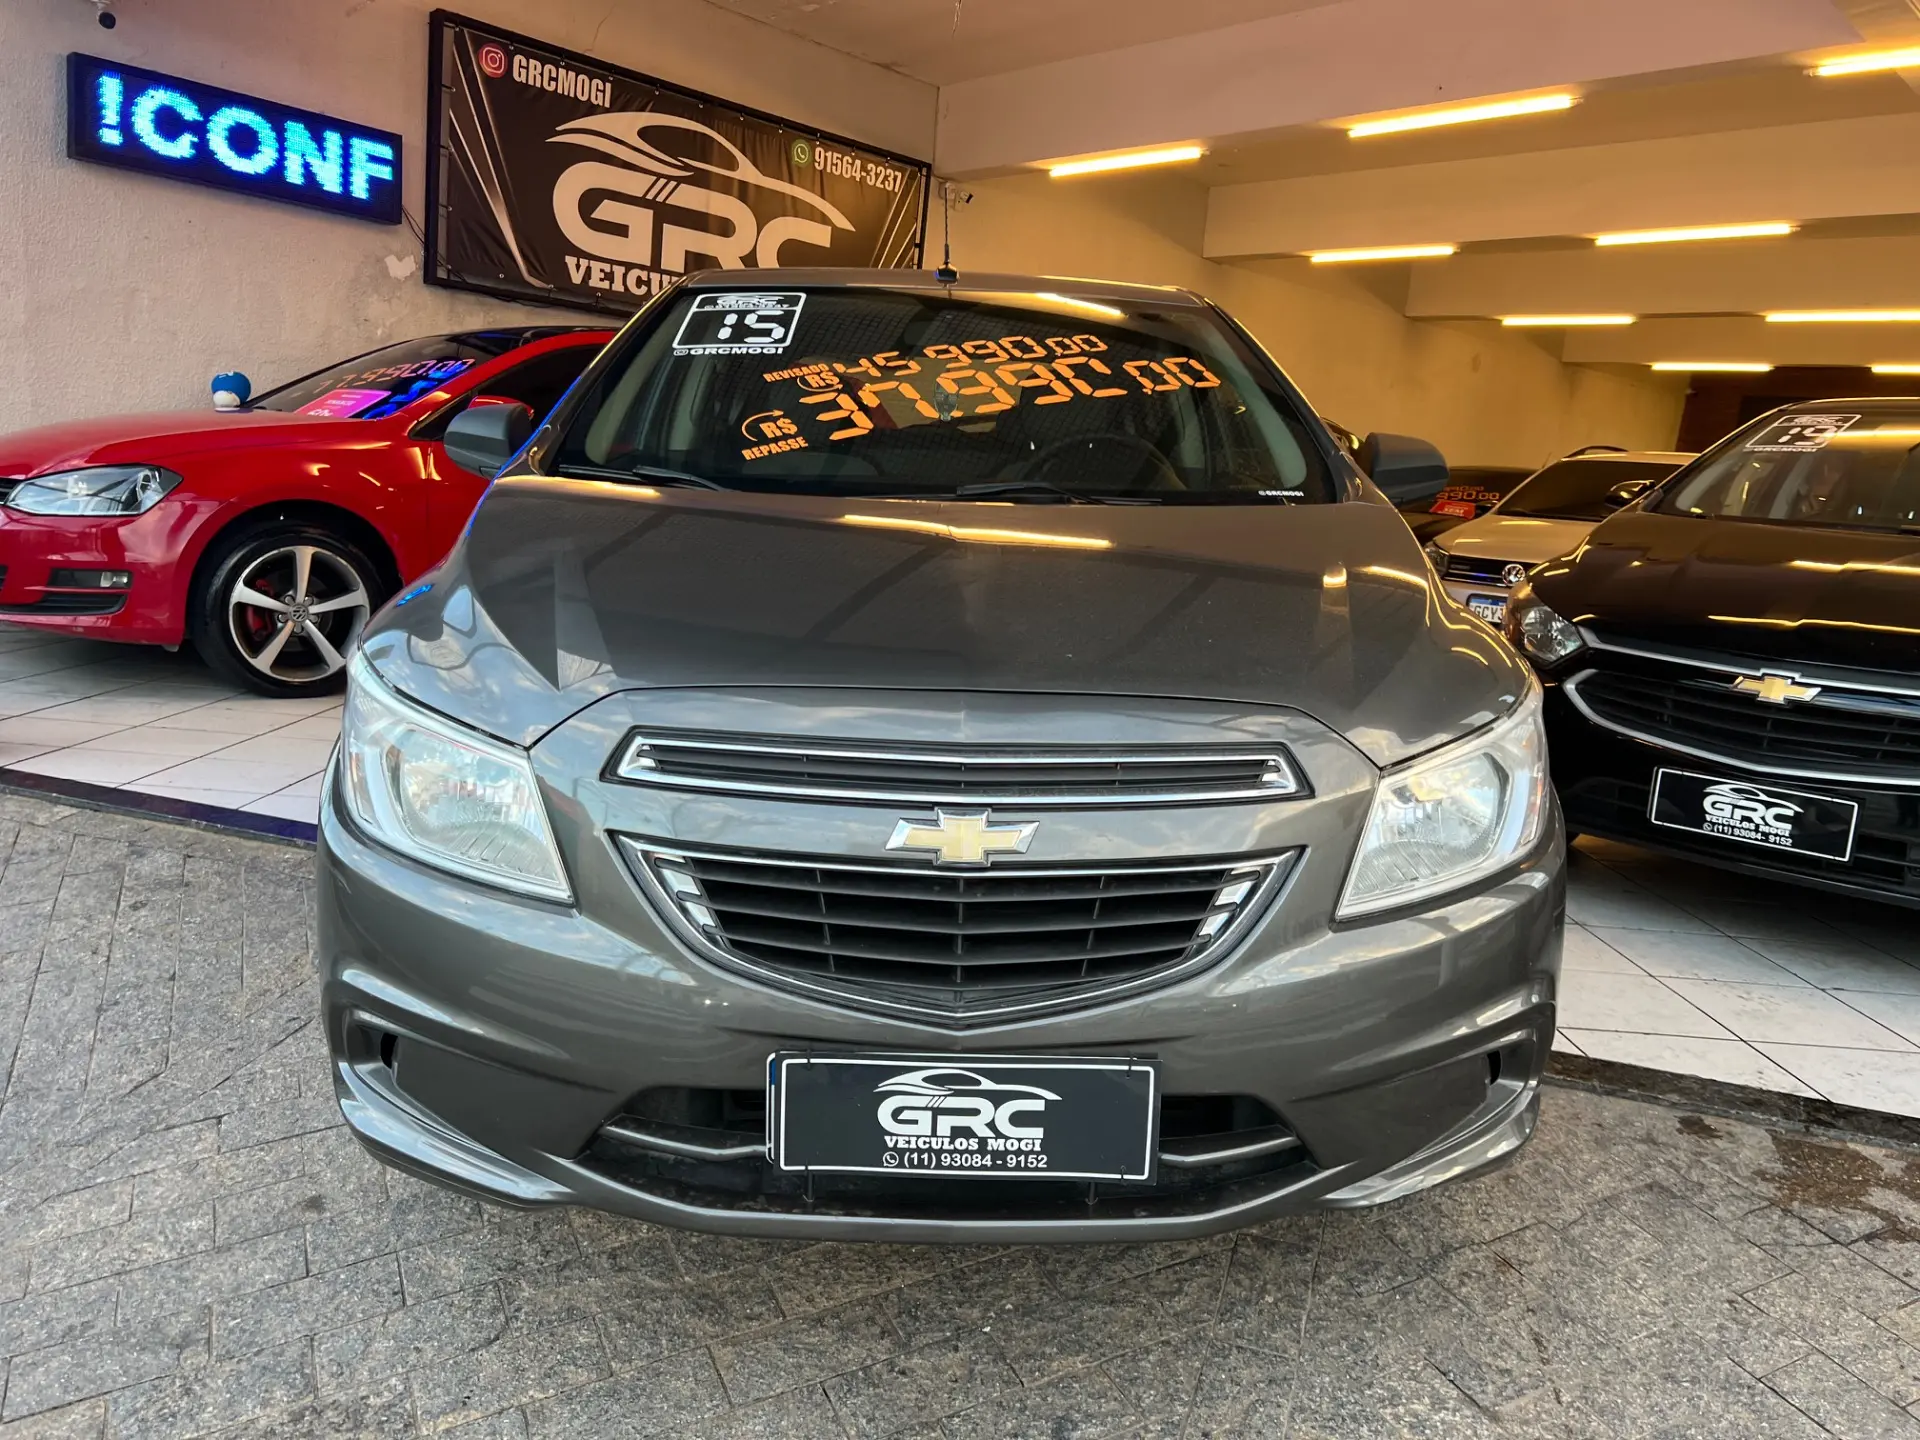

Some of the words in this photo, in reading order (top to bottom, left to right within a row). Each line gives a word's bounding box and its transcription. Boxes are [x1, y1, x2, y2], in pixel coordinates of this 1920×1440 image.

[512, 54, 612, 108] GRCMOGI
[814, 147, 902, 193] 91564-3237
[553, 161, 831, 269] GRC
[565, 255, 684, 296] VEICU
[763, 363, 830, 383] REVISADO
[804, 371, 840, 389] R$
[759, 417, 798, 439] R$
[741, 436, 809, 461] REPASSE
[1703, 794, 1795, 830] GRC
[1705, 814, 1756, 830] VEICULOS
[1759, 824, 1790, 837] MOGI
[1714, 824, 1732, 835] (11)
[1768, 834, 1793, 846] 9152
[877, 1094, 1046, 1139] GRC
[884, 1136, 979, 1150] VEICULOS
[987, 1139, 1042, 1151] MOGI
[904, 1152, 936, 1169] (11)
[941, 1153, 993, 1168] 93084
[1006, 1154, 1048, 1168] 9152
